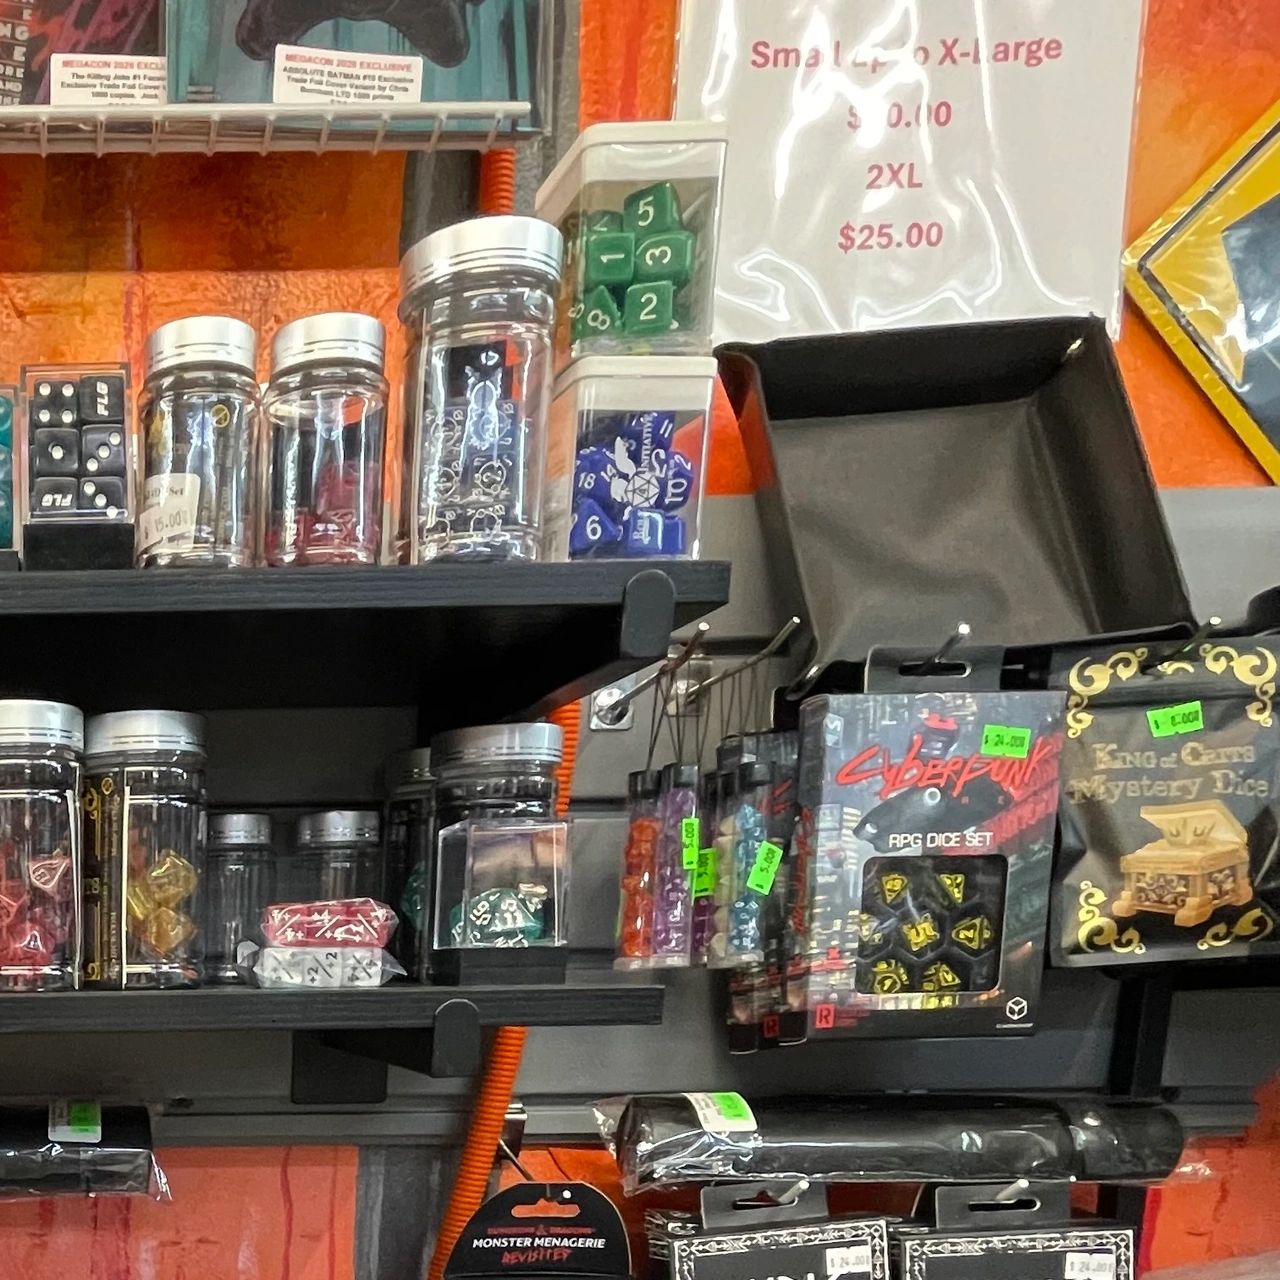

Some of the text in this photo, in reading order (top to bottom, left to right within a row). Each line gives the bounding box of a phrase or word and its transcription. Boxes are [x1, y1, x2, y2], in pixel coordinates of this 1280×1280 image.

[285, 54, 412, 72] MEGACON EXCLUSIVE
[751, 41, 841, 68] Smal
[328, 71, 360, 80] BATMAN
[847, 101, 952, 132] $0.00
[866, 163, 923, 189] 2XL
[635, 195, 657, 226] 5
[838, 221, 943, 254] $25.00
[645, 246, 671, 267] 3
[639, 293, 659, 321] 2
[586, 515, 602, 540] 6
[1069, 770, 1269, 804] Mystery Dice
[889, 831, 993, 849] RPG DICE SET
[472, 1237, 606, 1248] MONSTER MENAGERIE
